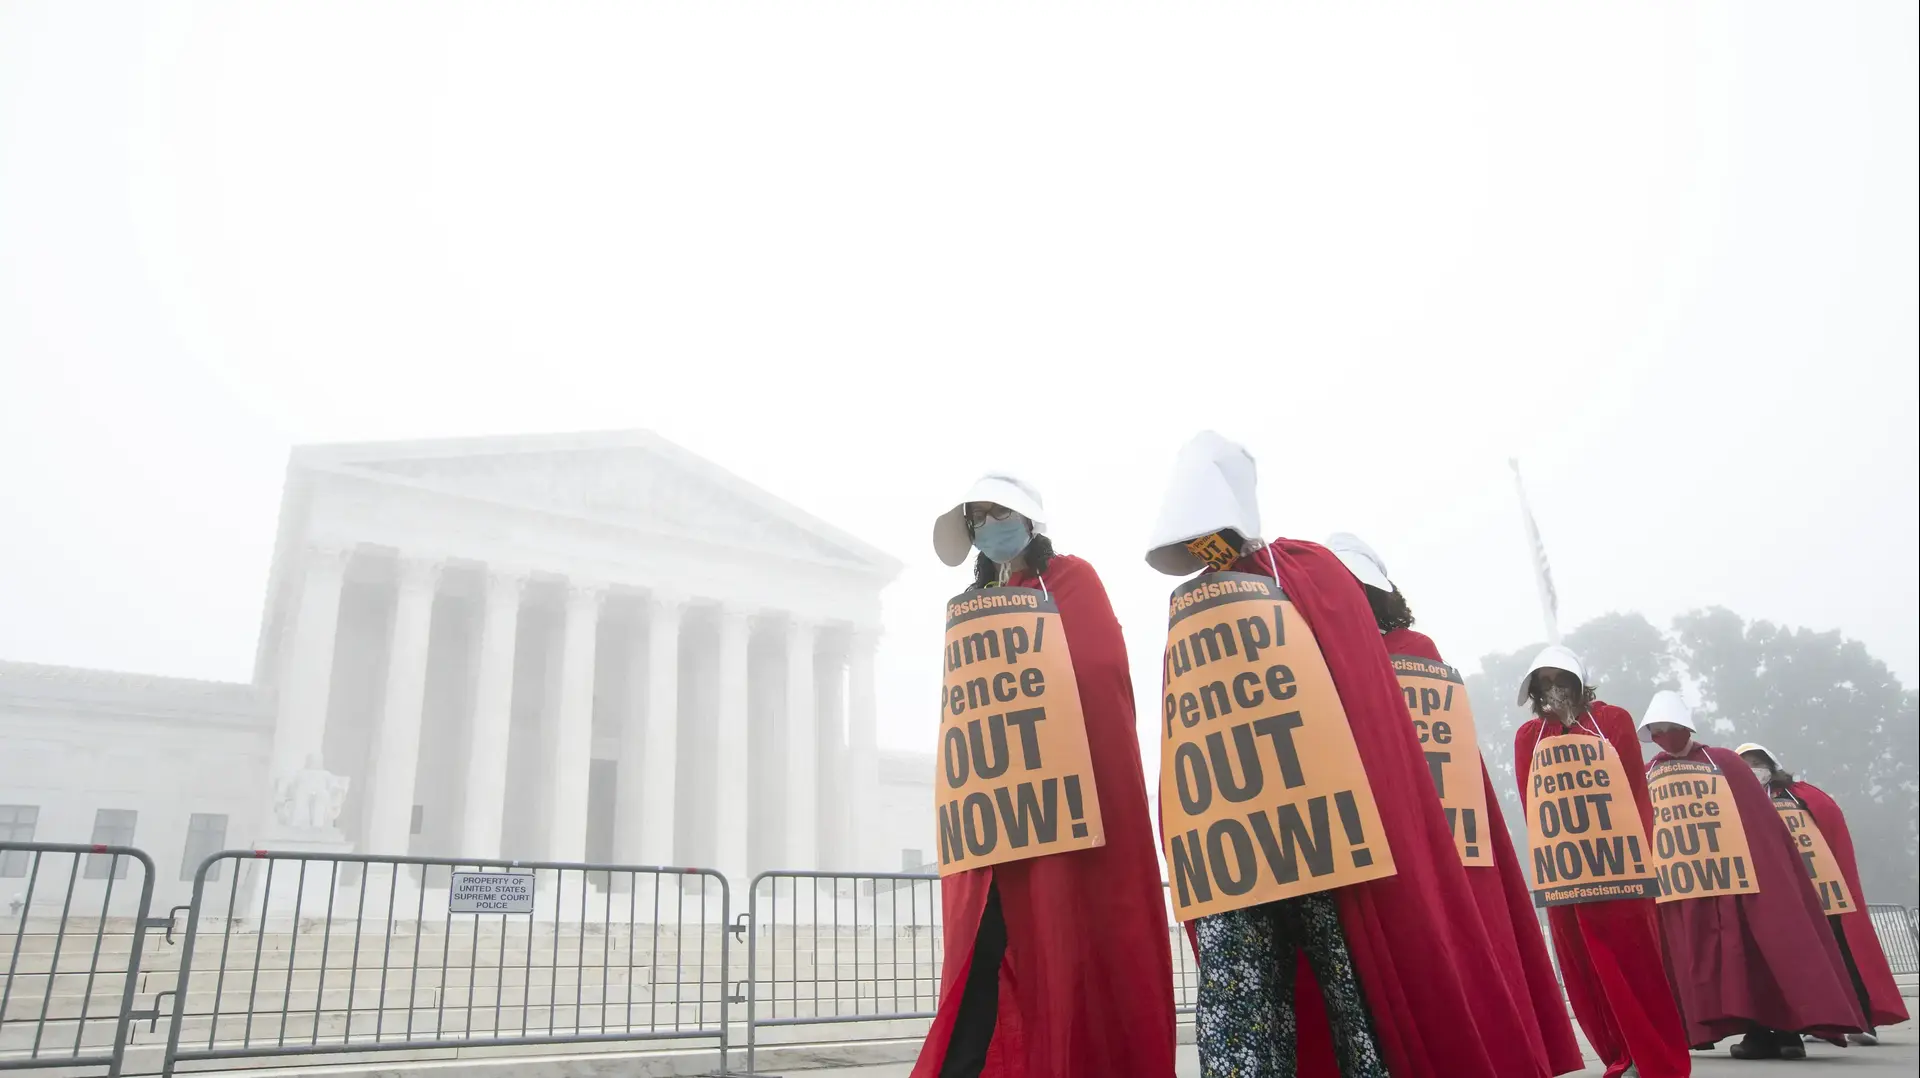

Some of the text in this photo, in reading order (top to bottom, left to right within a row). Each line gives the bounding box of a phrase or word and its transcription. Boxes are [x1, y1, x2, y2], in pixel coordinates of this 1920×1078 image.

[1165, 664, 1297, 739] Pence
[944, 706, 1047, 789] OUT
[1175, 711, 1306, 816] OUT
[1534, 769, 1610, 797] Pence
[939, 774, 1089, 865] NOW!
[1539, 793, 1612, 839] OUT
[1653, 801, 1720, 826] Pence
[1171, 789, 1374, 909] NOW!
[1533, 835, 1645, 885] NOW!
[1656, 821, 1721, 860] OUT
[462, 876, 509, 885] PROPERTY
[494, 885, 526, 893] STATES
[1544, 883, 1645, 902] RefuseFascism.org
[1655, 856, 1749, 897] NOW!
[454, 893, 497, 901] SUPREME
[476, 901, 508, 909] POLICE
